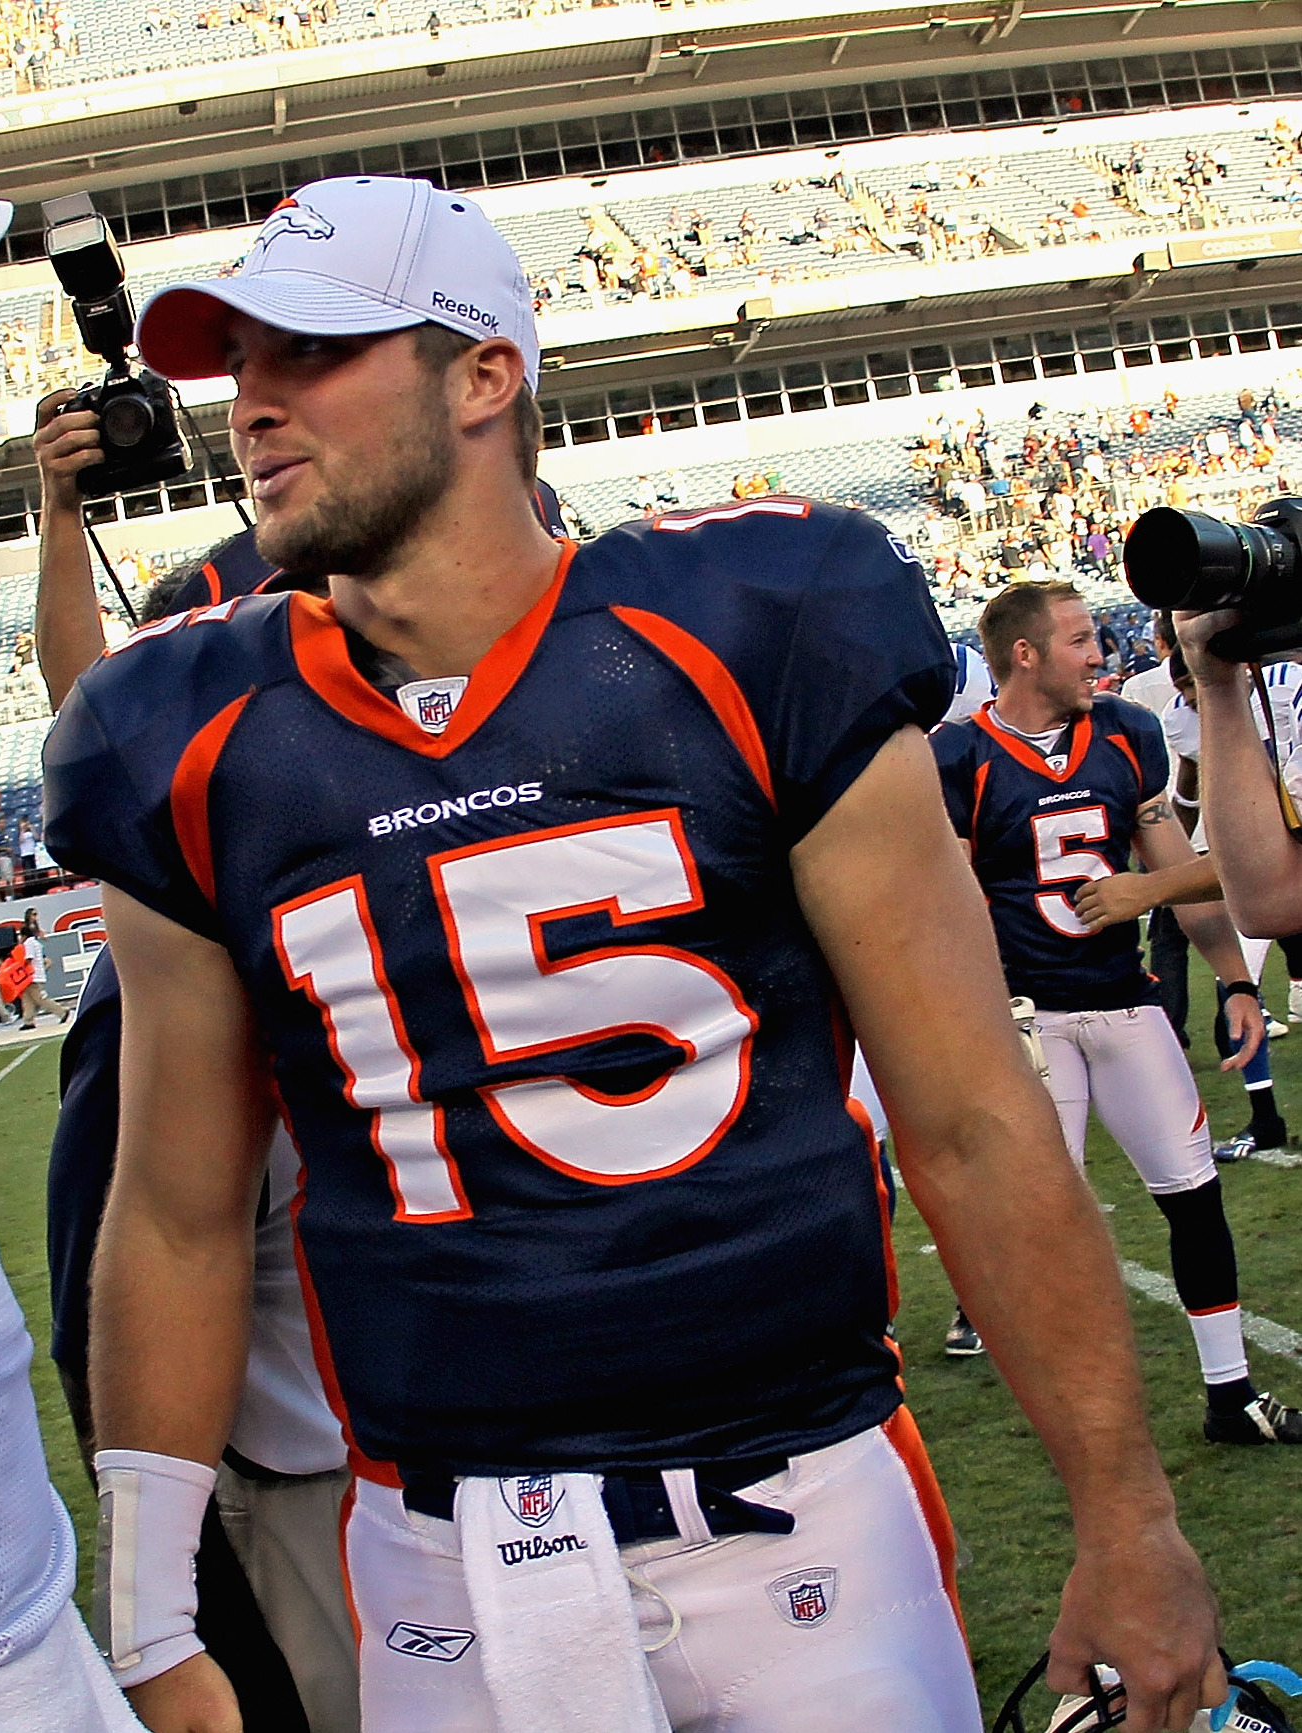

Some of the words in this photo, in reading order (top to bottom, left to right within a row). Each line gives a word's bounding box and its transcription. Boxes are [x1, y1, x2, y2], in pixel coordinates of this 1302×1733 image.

[432, 290, 500, 335] Reebok
[422, 703, 454, 722] NFL
[367, 781, 544, 838] BRONCOS
[1038, 789, 1091, 807] BRONCOS
[1030, 804, 1115, 938] 5
[270, 807, 761, 1226] 15
[519, 1491, 550, 1516] NFL
[497, 1535, 588, 1566] Wilson
[794, 1598, 825, 1618] NFL
